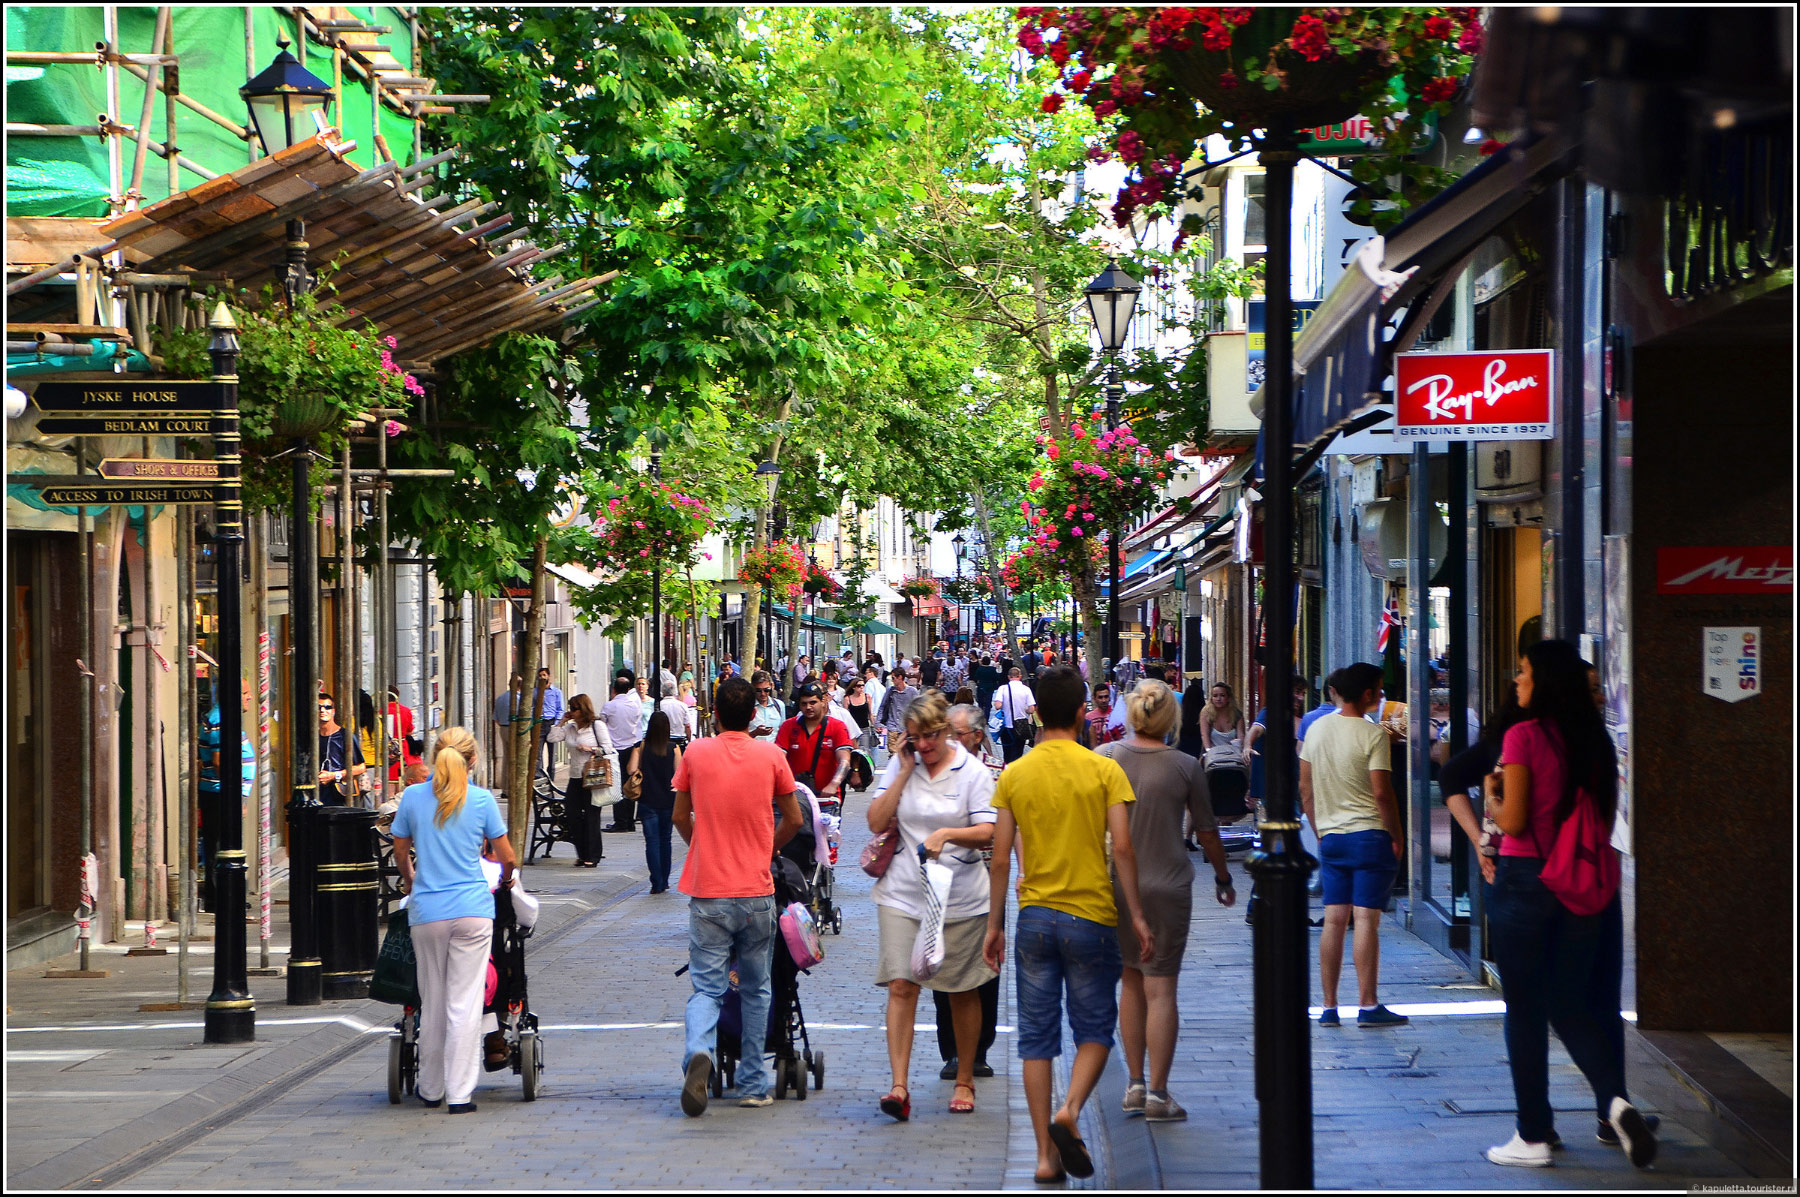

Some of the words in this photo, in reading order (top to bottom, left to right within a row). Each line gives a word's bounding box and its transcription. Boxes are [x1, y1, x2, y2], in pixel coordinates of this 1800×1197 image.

[1407, 359, 1538, 420] Ray-Ban
[82, 391, 122, 404] JYSKE
[132, 391, 178, 402] HOUSE
[104, 421, 159, 432] BEDLAM
[167, 420, 210, 431] COURT
[1400, 427, 1461, 436] GENUINE
[1466, 426, 1509, 435] SINCE
[1514, 425, 1546, 434] 1937
[135, 464, 165, 476] SHOPS
[169, 465, 177, 475] &
[182, 464, 219, 476] OFFICES
[50, 490, 97, 501] ACCESS
[106, 490, 123, 501] TO
[130, 489, 167, 501] IRISH
[175, 489, 213, 500] TOWN
[1708, 631, 1728, 642] Top
[1709, 646, 1723, 655] up
[1737, 632, 1756, 691] Shine
